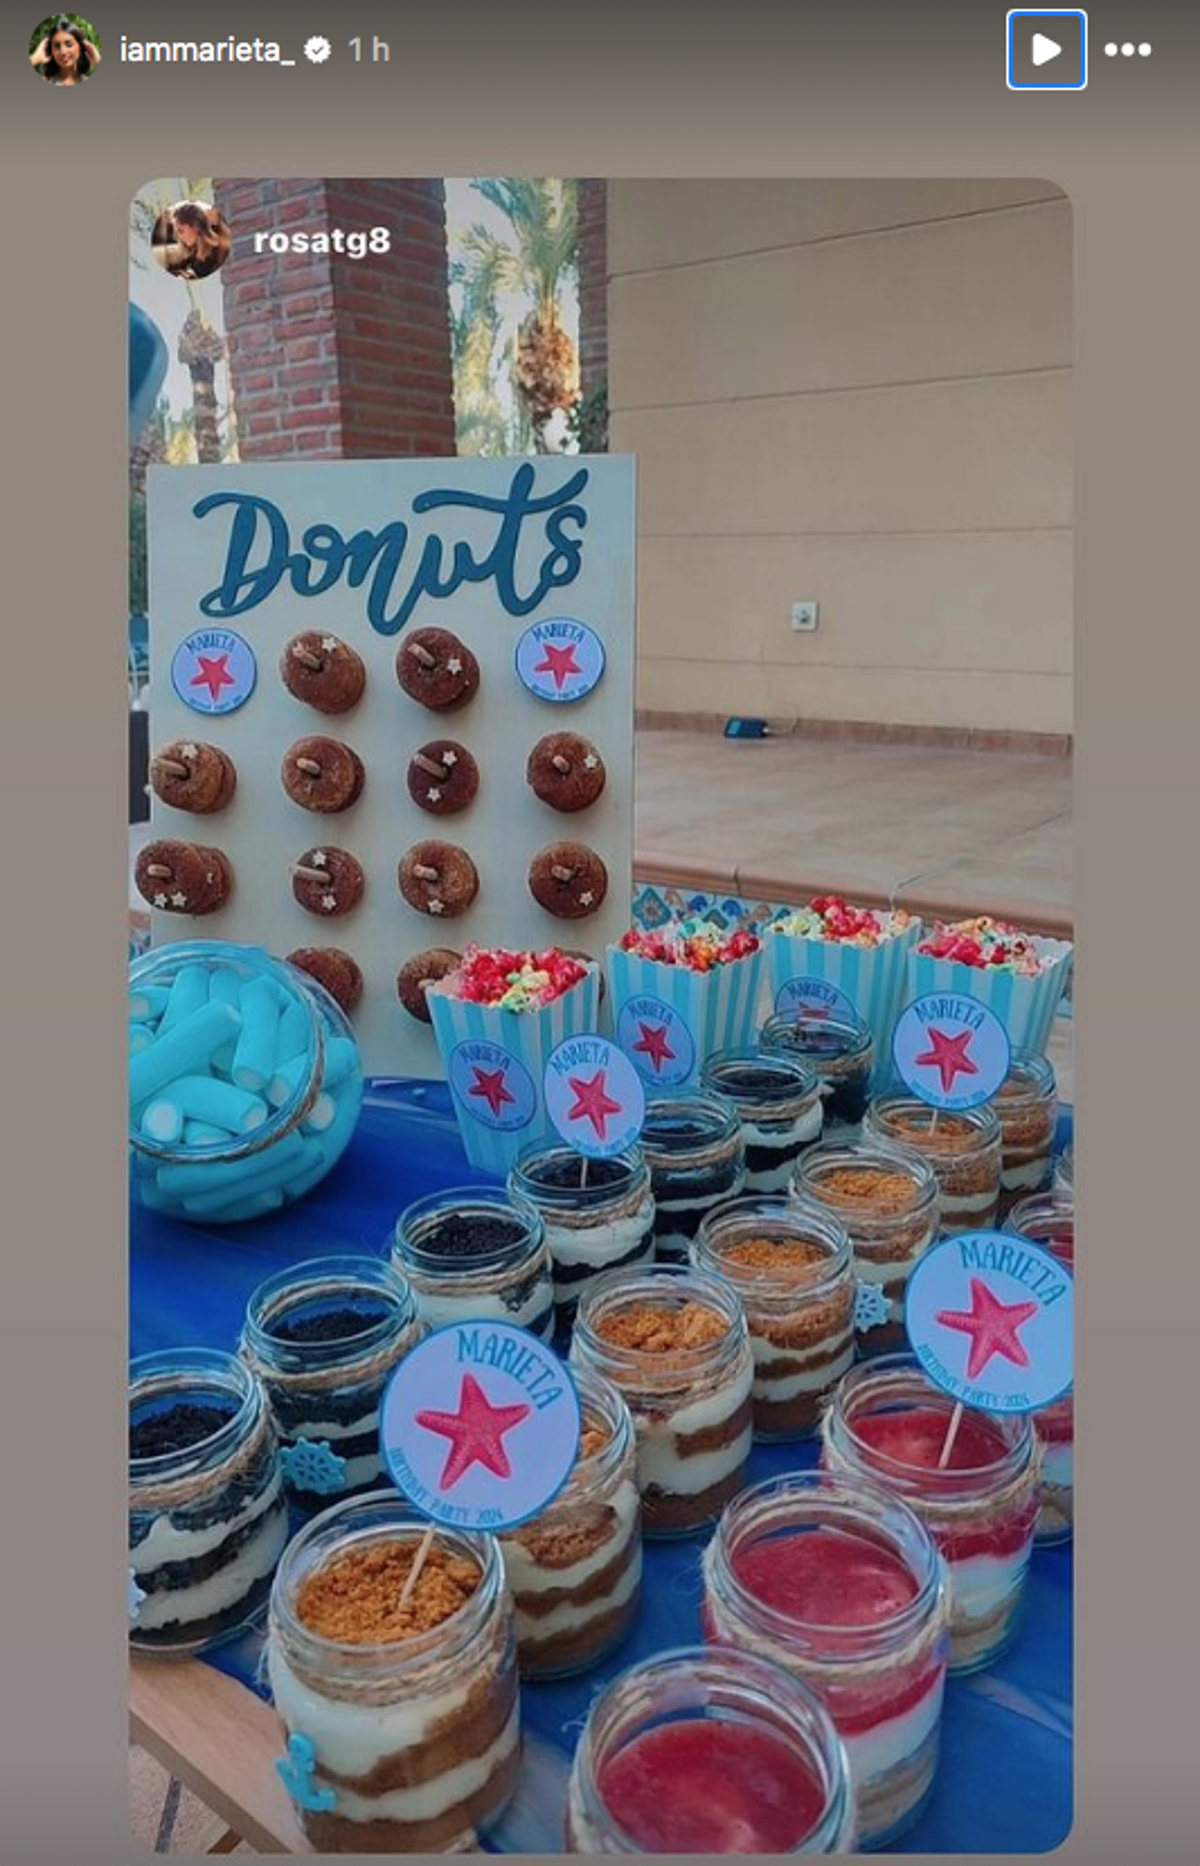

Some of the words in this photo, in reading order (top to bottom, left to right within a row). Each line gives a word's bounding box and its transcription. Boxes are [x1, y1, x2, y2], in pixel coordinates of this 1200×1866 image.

[192, 463, 589, 636] Donuts
[186, 632, 236, 655] MARIETA
[530, 622, 586, 643] MARIETA
[787, 980, 839, 1005] MARIETA
[628, 998, 674, 1026] MARIETA
[914, 999, 985, 1031] MARIETA
[460, 1045, 510, 1070] MARIETA
[551, 1039, 611, 1076] MARIETA
[957, 1239, 1067, 1306] MARIETA
[456, 1329, 564, 1410] MARIETA
